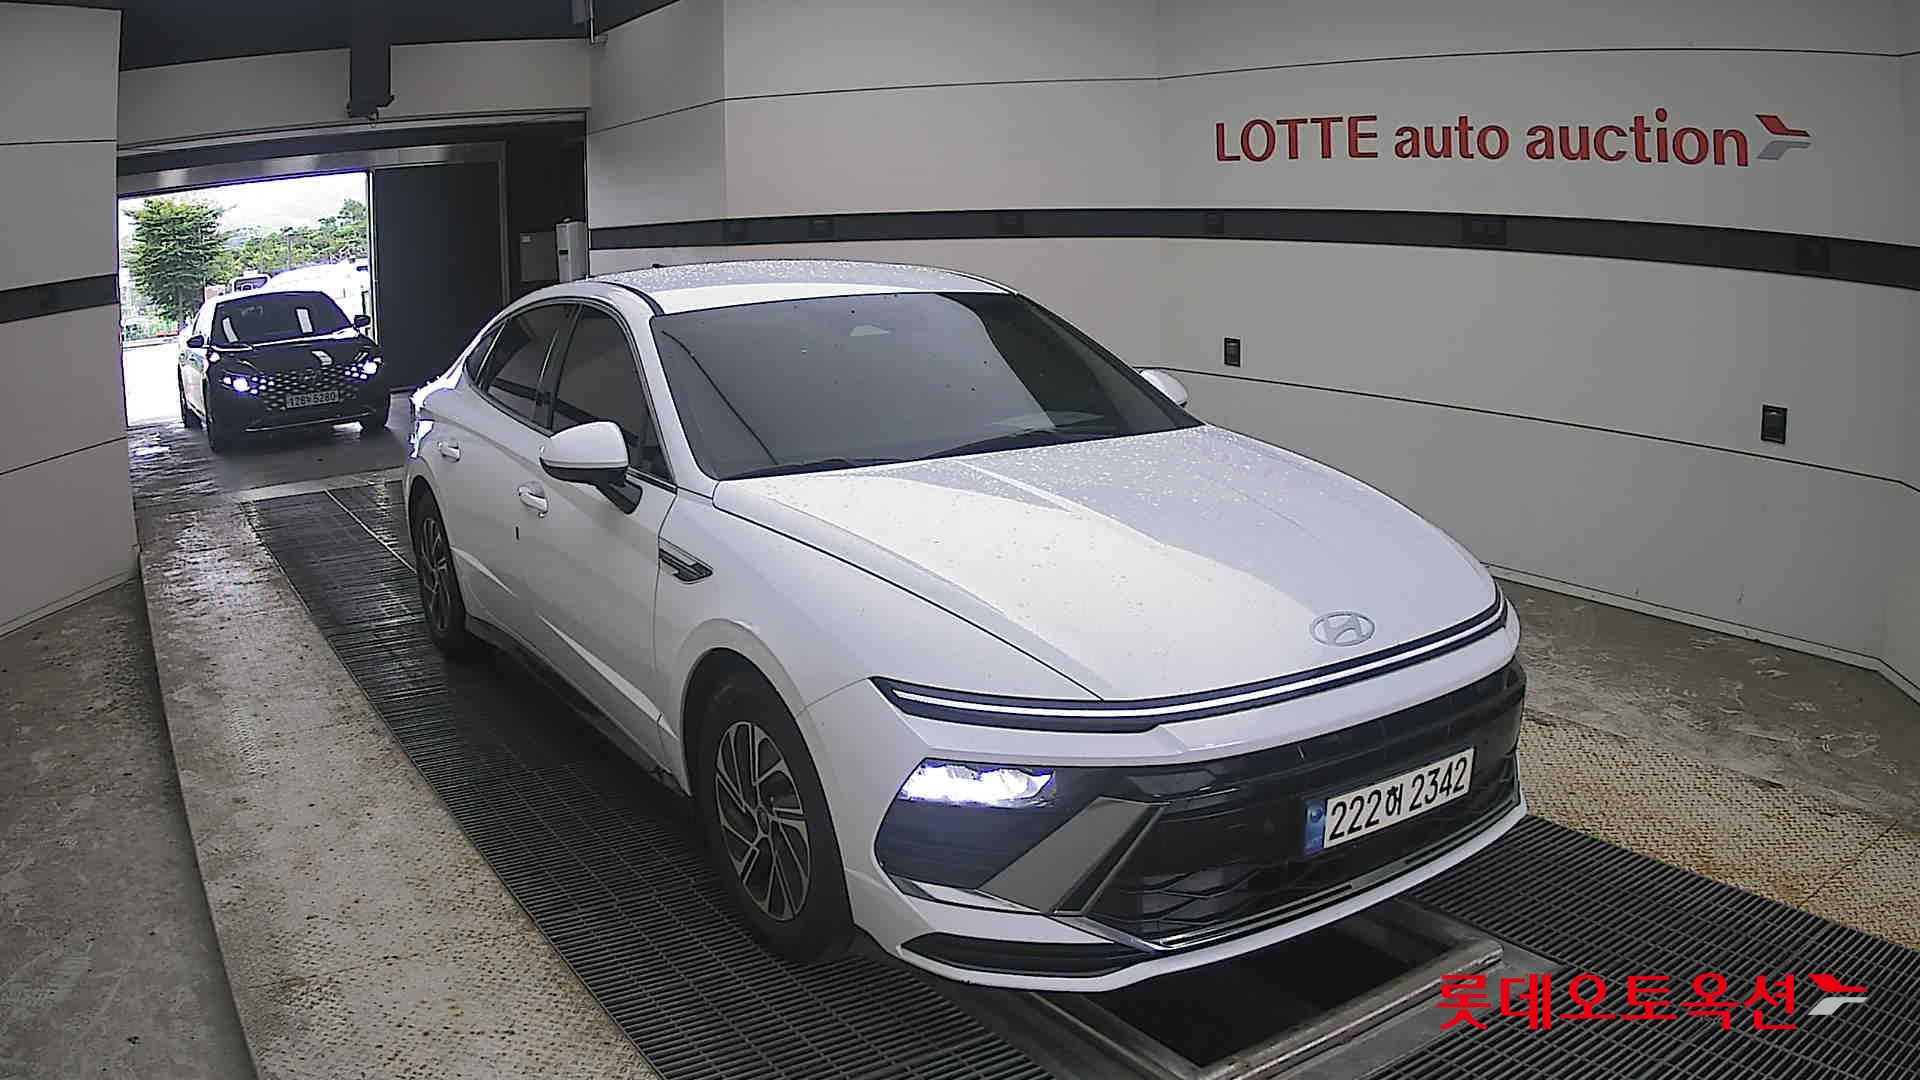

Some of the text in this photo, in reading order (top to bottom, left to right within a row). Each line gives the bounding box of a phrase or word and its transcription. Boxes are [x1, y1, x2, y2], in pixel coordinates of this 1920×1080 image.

[1215, 107, 1750, 166] LOTTE auto auction
[1329, 757, 1468, 841] 222허 2342
